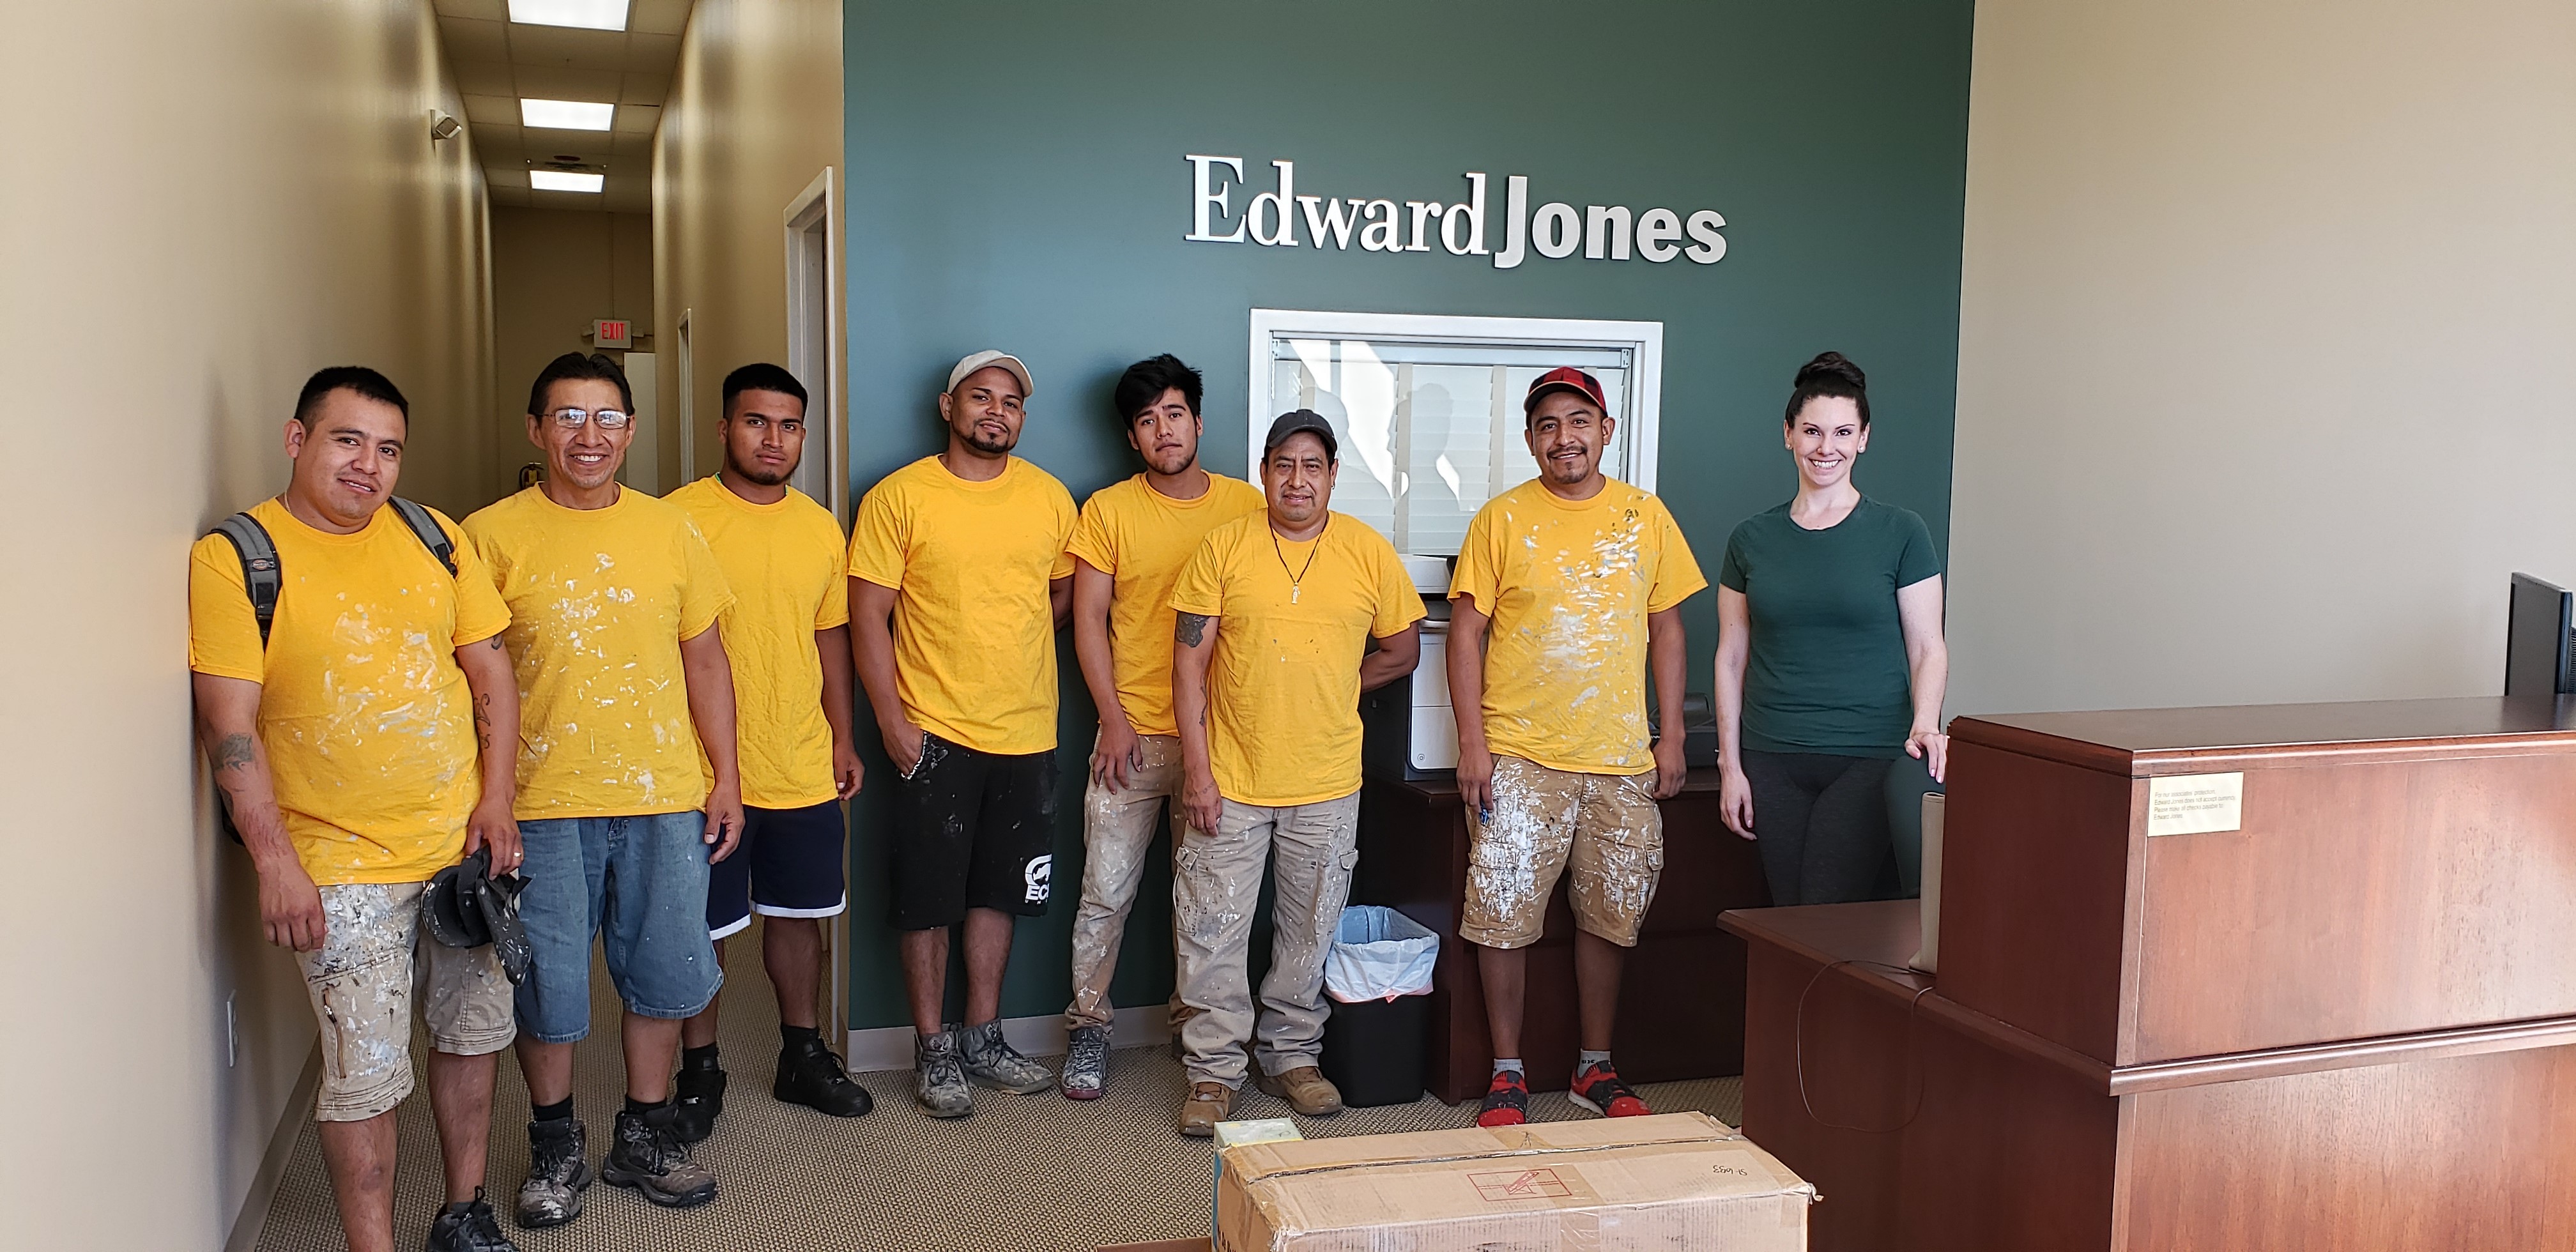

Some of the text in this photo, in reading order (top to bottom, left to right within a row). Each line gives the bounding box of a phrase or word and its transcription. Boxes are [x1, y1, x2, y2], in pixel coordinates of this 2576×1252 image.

[1185, 154, 1728, 268] Edward Jones
[601, 322, 625, 340] EXIT
